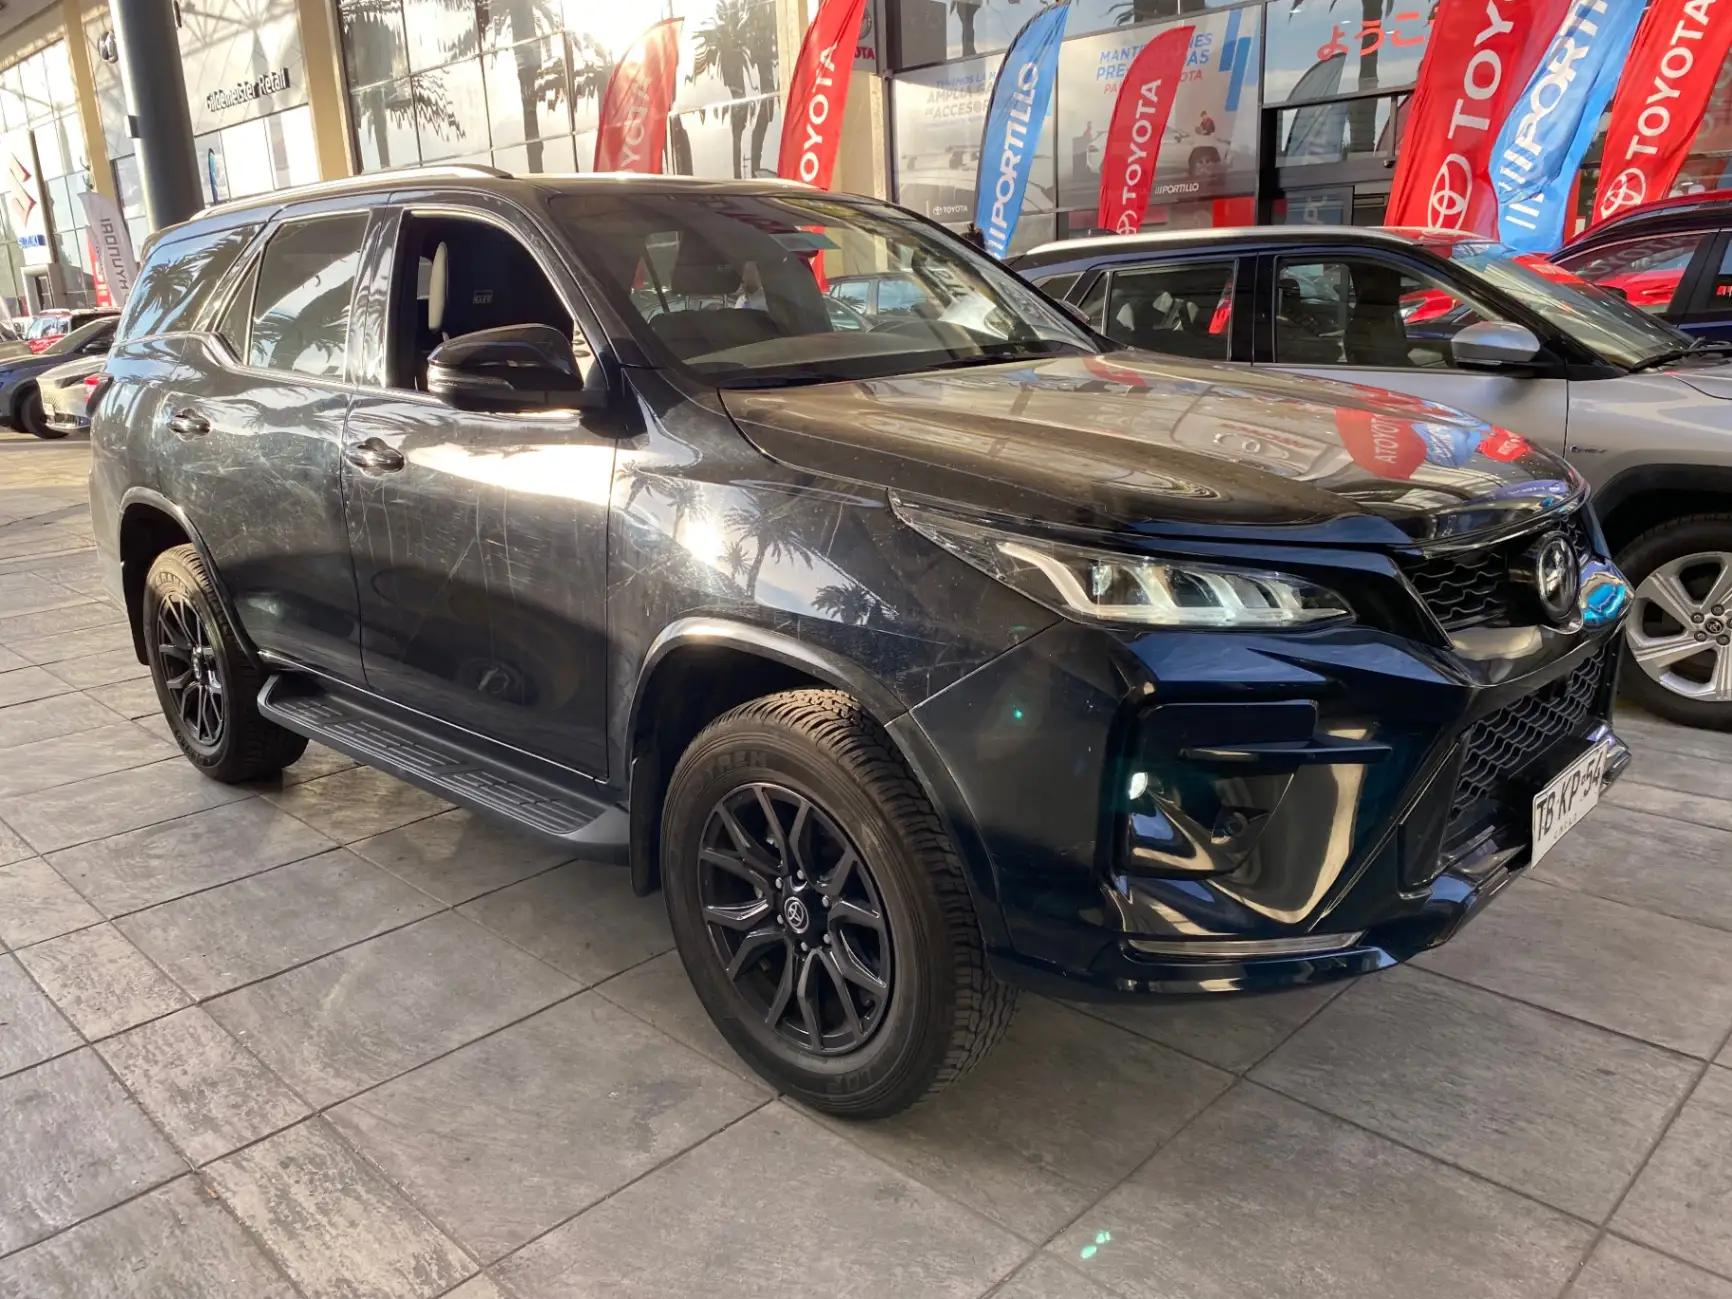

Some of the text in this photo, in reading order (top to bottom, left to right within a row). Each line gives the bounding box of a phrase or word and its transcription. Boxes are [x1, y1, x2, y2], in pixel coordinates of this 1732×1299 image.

[855, 46, 875, 60] OTA
[1317, 10, 1425, 62] ようこ
[1448, 0, 1514, 139] TOY
[1625, 0, 1717, 161] TOYOTA
[800, 41, 838, 183] OYOTA
[1122, 79, 1162, 205] TOYOTA
